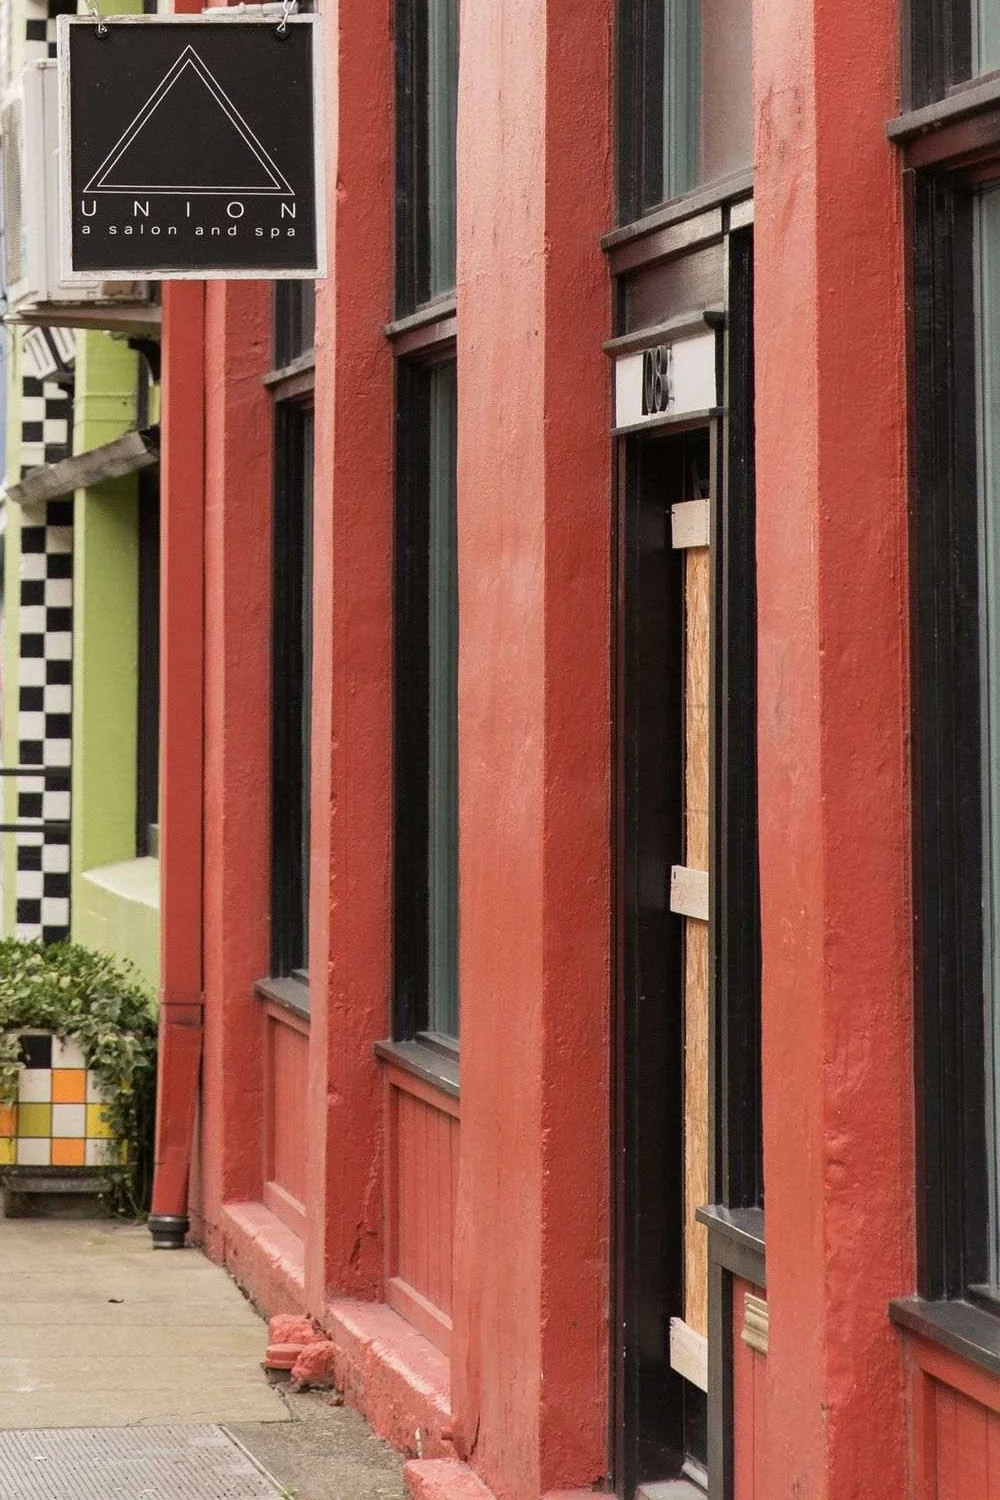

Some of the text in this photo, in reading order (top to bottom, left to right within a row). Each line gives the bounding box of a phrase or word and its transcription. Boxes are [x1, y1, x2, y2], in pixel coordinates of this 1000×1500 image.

[81, 200, 297, 219] UNION
[81, 223, 297, 240] a salon and spa
